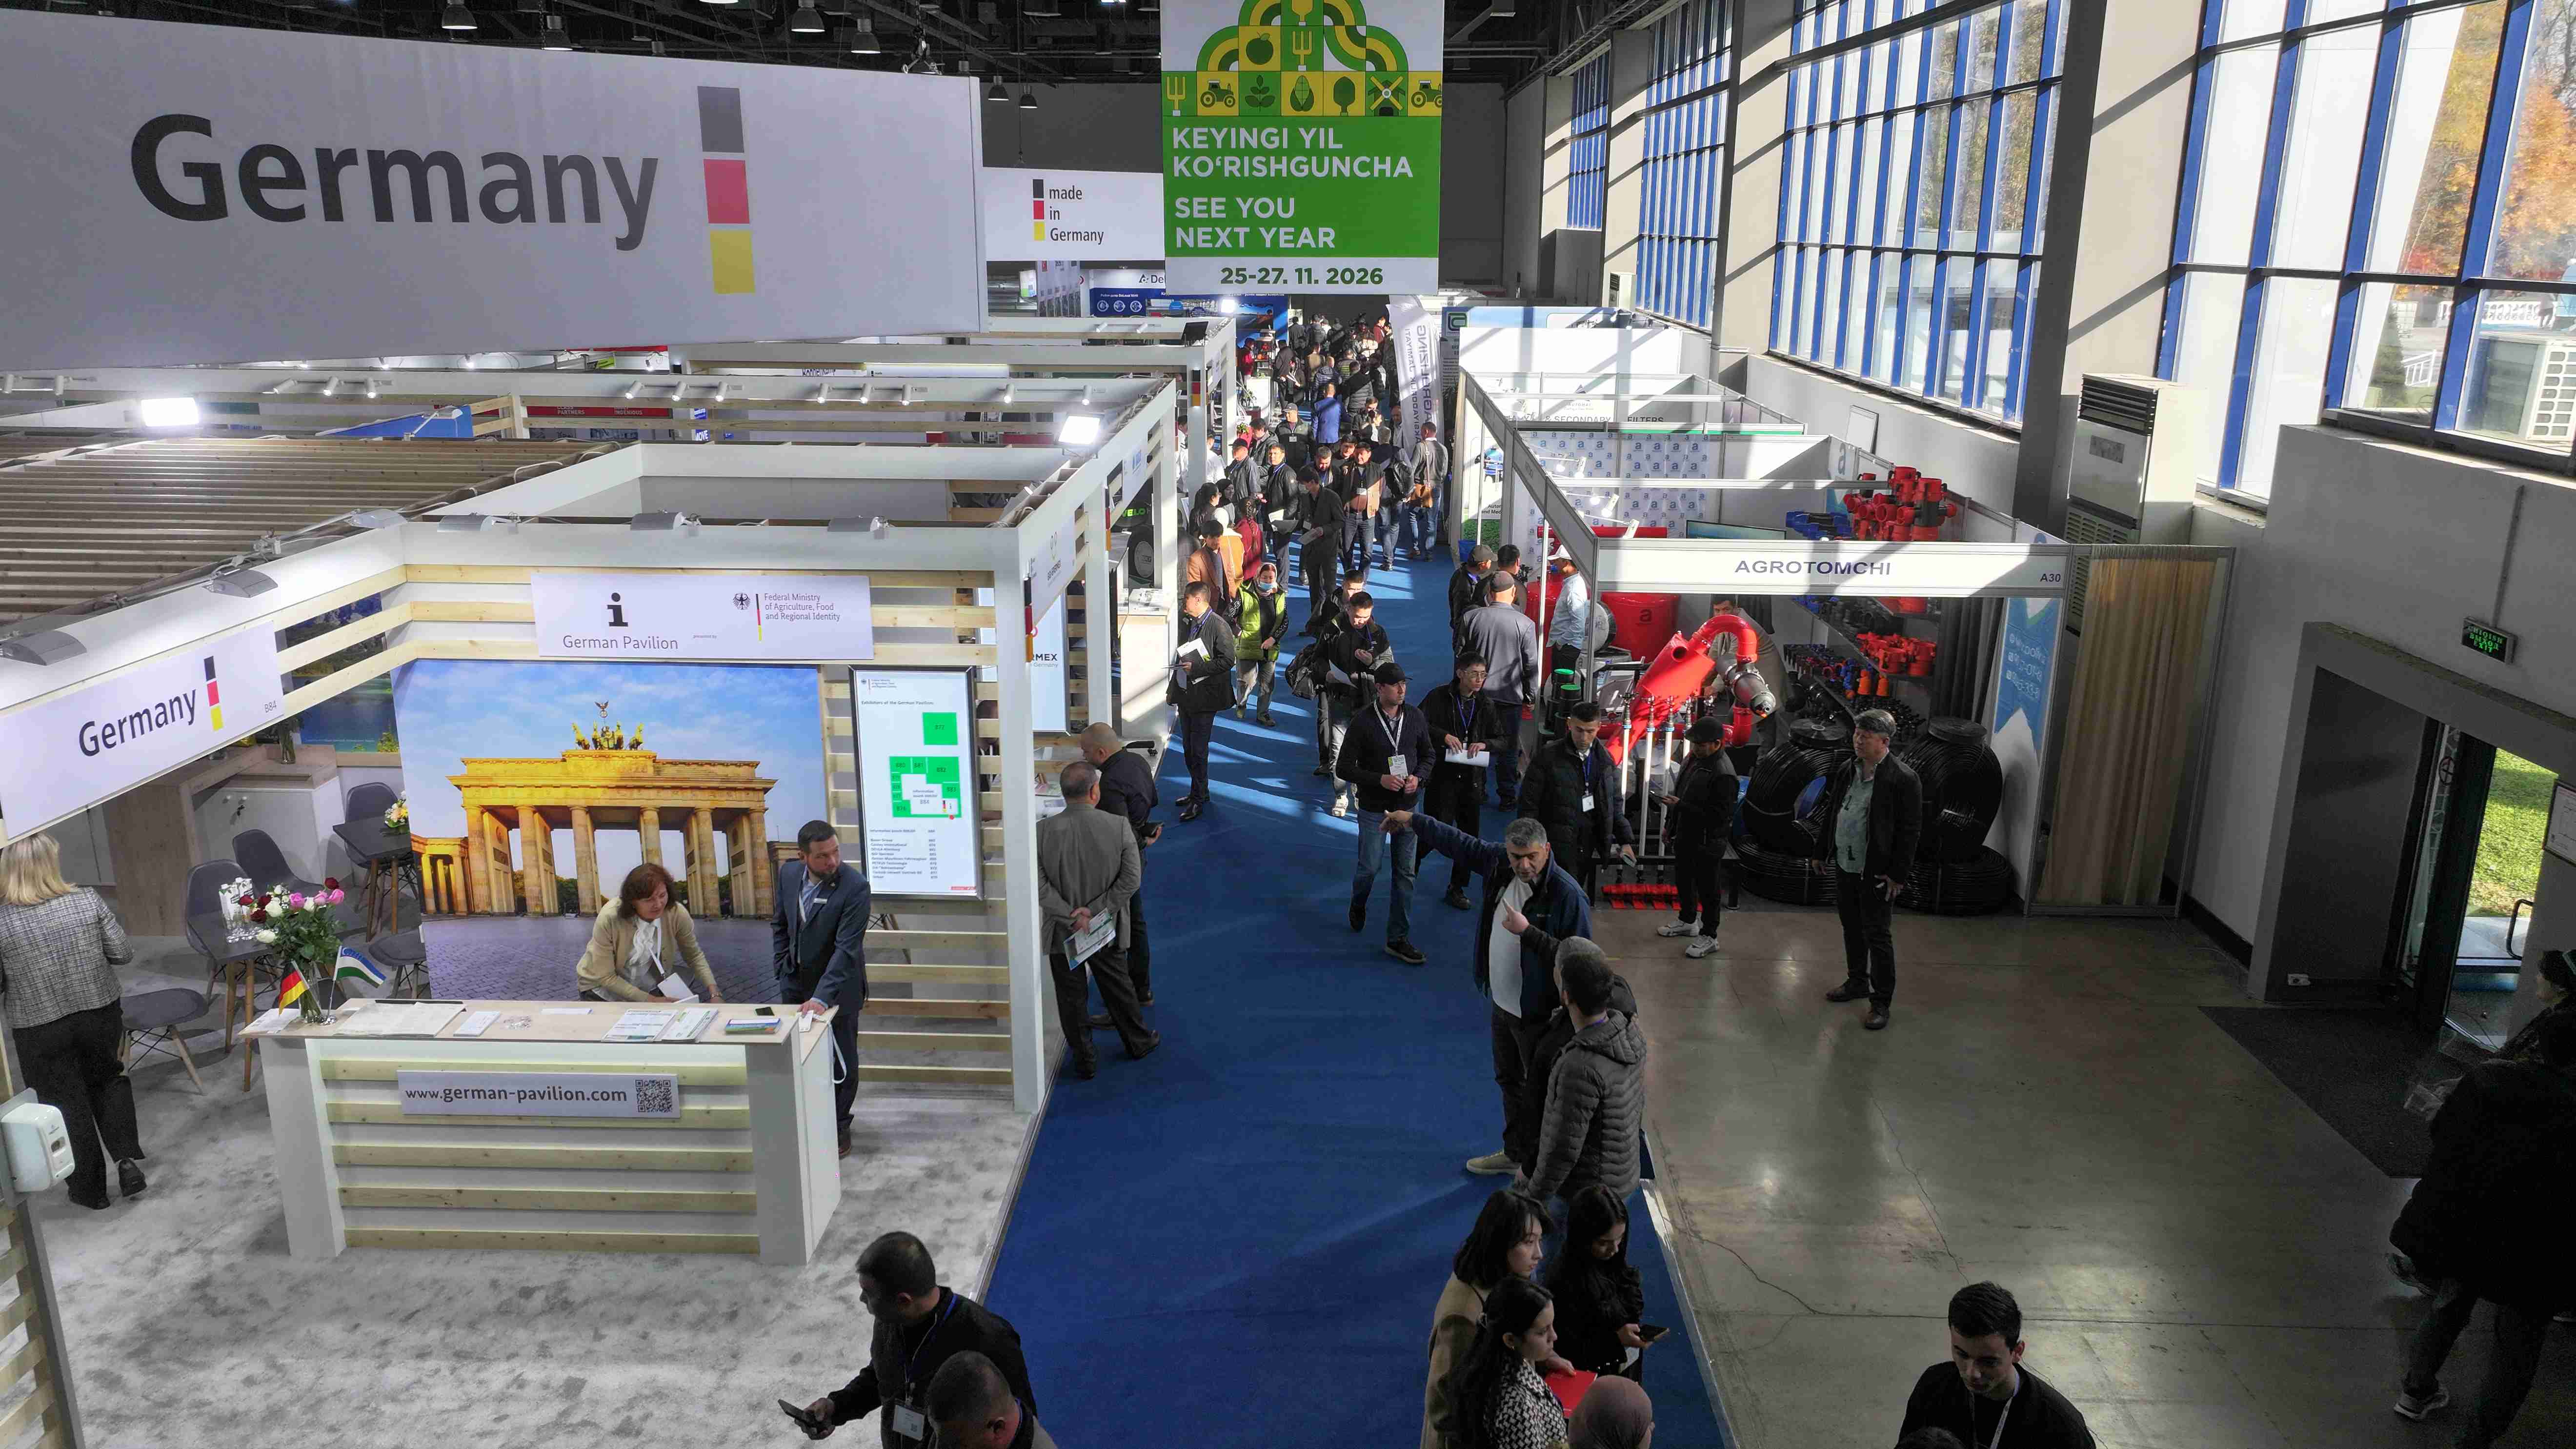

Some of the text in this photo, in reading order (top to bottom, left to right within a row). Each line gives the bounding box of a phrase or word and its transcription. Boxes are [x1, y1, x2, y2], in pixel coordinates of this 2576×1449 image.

[1173, 127, 1343, 149] KEYINGI YIL
[130, 113, 658, 251] Germany
[1048, 185, 1083, 200] made
[1049, 206, 1060, 221] in
[1175, 197, 1295, 219] SEE YOU
[1050, 227, 1104, 245] Germany
[1176, 227, 1335, 248] NEXT YEAR
[1151, 275, 1165, 283] De
[1220, 267, 1383, 285] 25-27. 11. 2026
[1735, 560, 1891, 575] AGROTOMCHI
[2040, 573, 2062, 583] A30
[764, 593, 821, 603] Federal Ministry
[774, 603, 815, 612] Agriculture,
[816, 603, 834, 611] Food
[781, 612, 811, 621] Regional
[812, 612, 840, 622] Identity
[1640, 609, 1653, 622] a
[563, 635, 678, 649] German Pavilion
[264, 700, 277, 713] B84
[79, 689, 197, 757] Germany
[405, 1086, 627, 1104] www.german-pavilion.com
